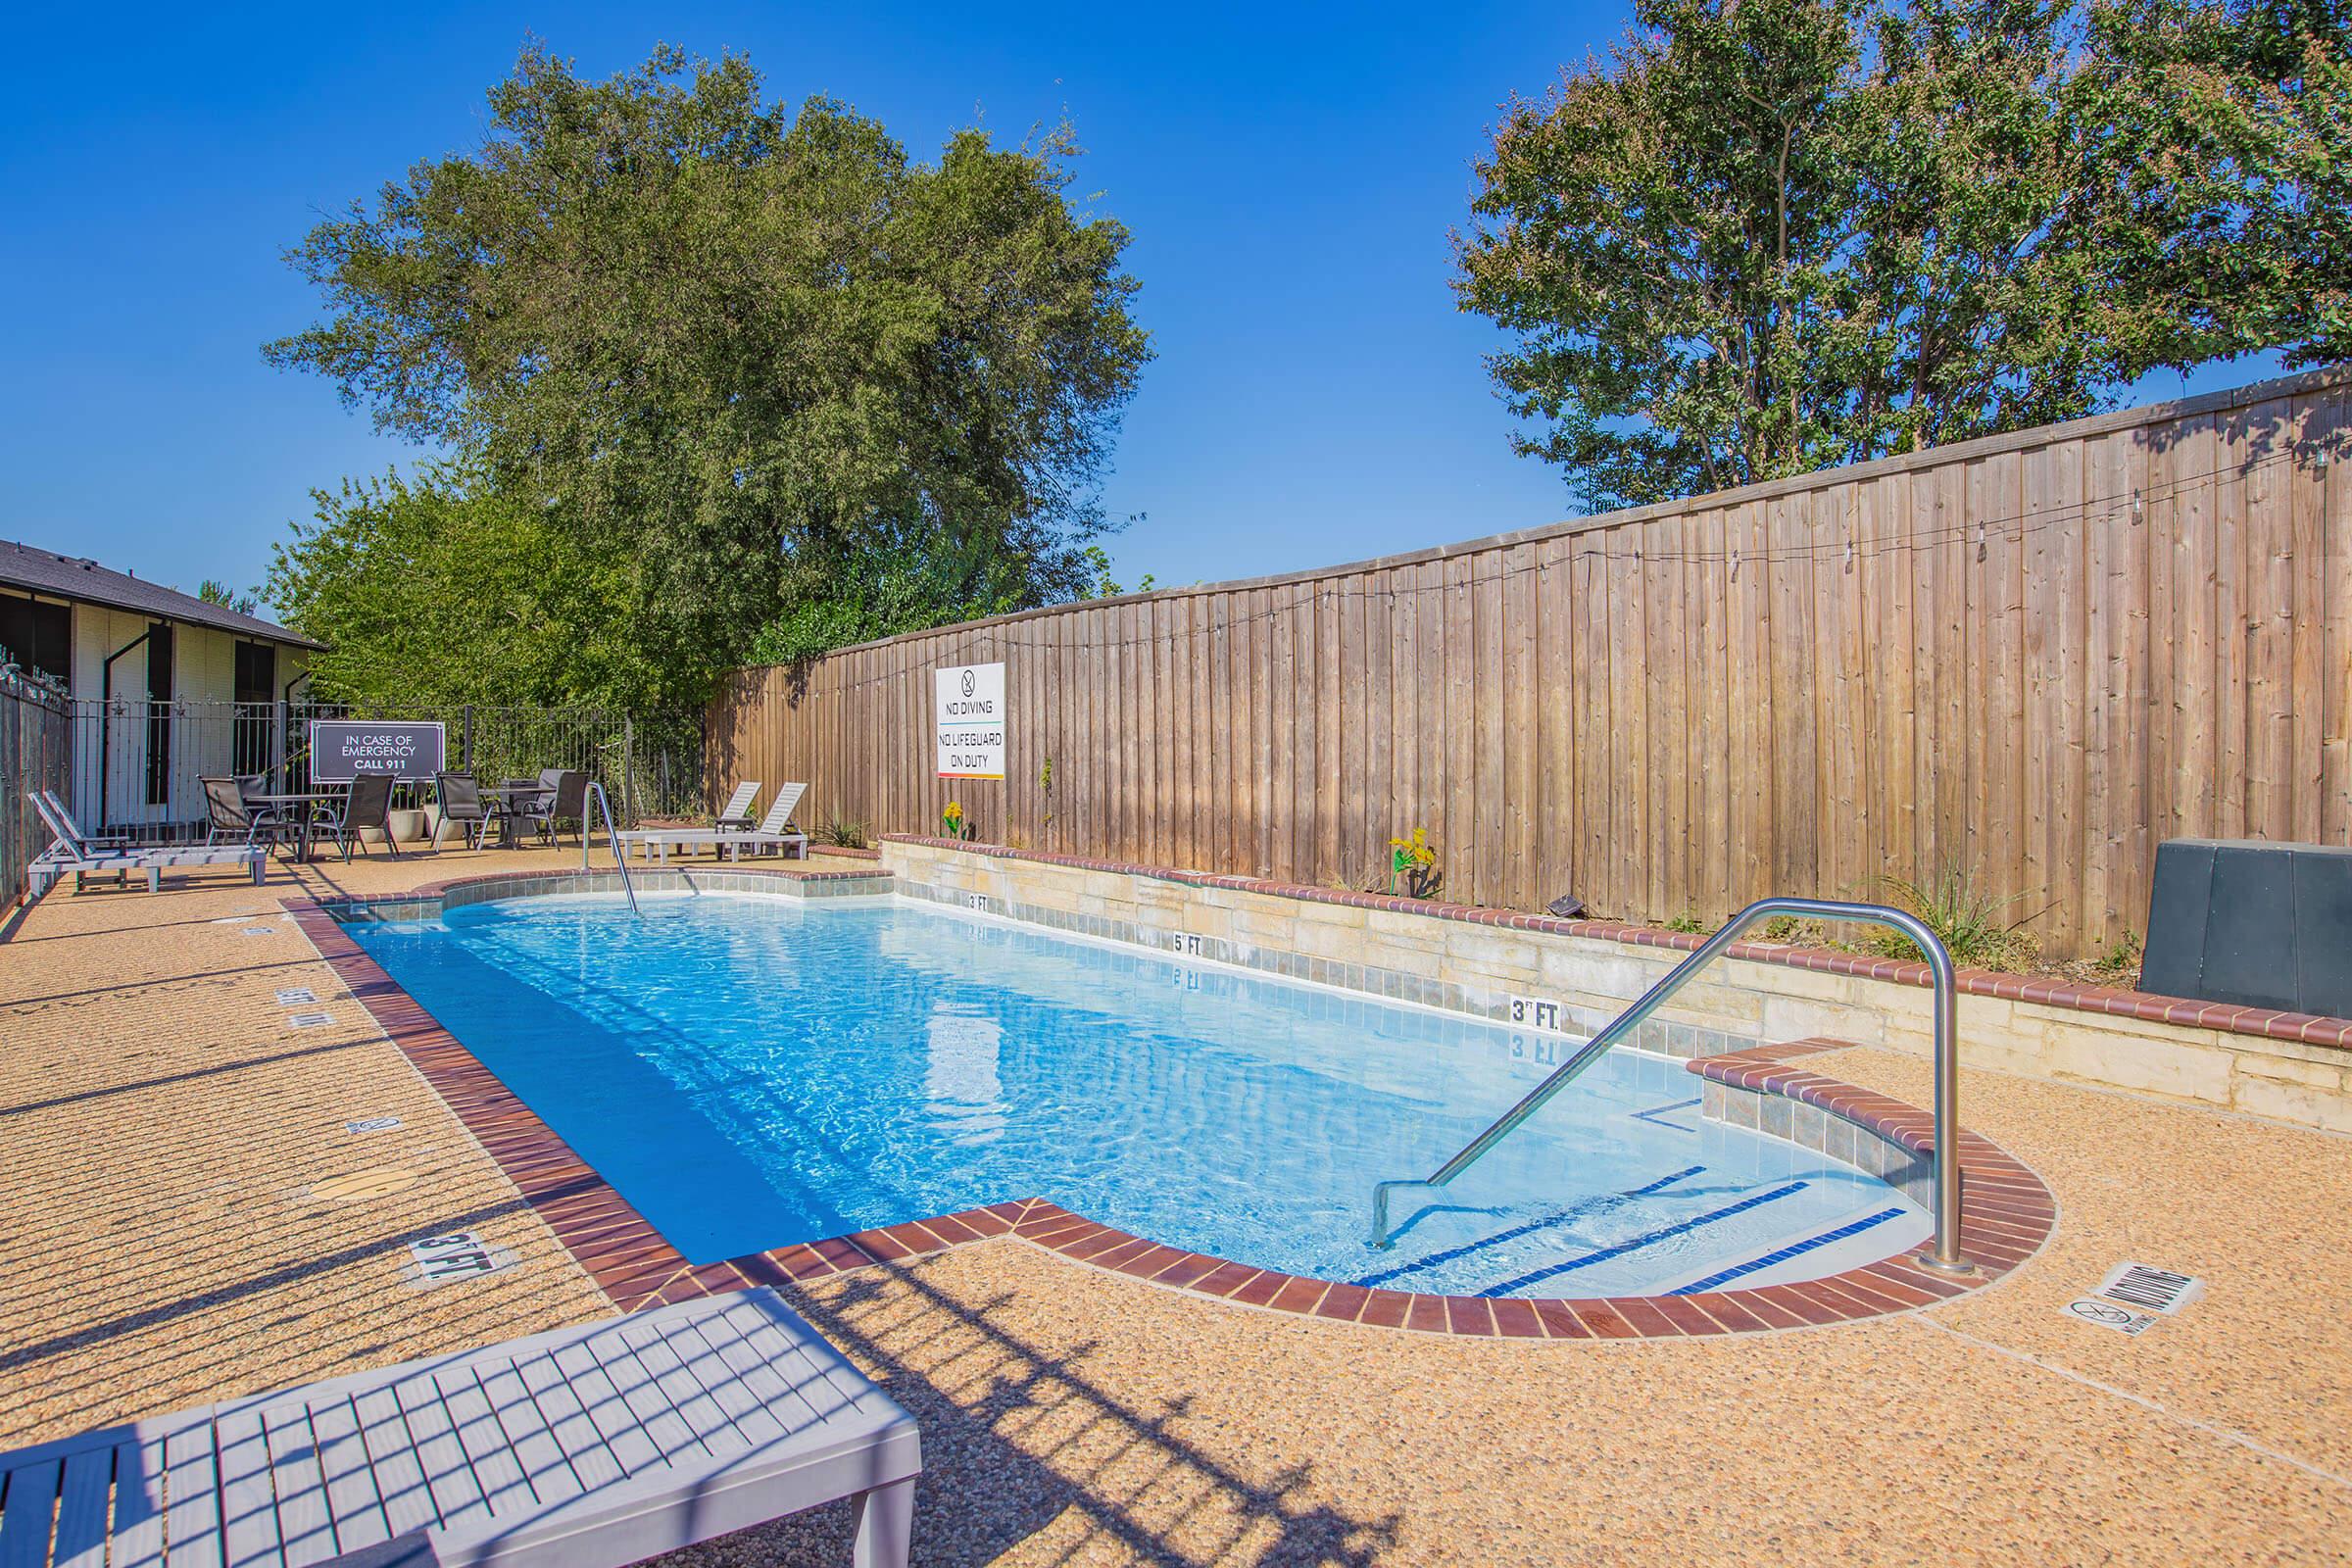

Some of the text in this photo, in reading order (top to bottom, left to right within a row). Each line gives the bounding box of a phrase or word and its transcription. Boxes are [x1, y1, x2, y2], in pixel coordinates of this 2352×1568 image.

[946, 700, 993, 715] NO DIVING
[346, 735, 413, 746] IN CASE OF
[939, 732, 1003, 747] NO LIFEGUARD
[342, 746, 416, 757] EMERGENCY
[354, 760, 406, 769] CALL 911
[951, 754, 989, 768] ON DUTY
[969, 895, 975, 909] 3
[1175, 934, 1182, 952] 5
[1512, 1000, 1525, 1022] 3
[1536, 1002, 1558, 1030] FT.
[418, 1234, 471, 1250] 3
[2103, 1265, 2192, 1311] NO DIVING
